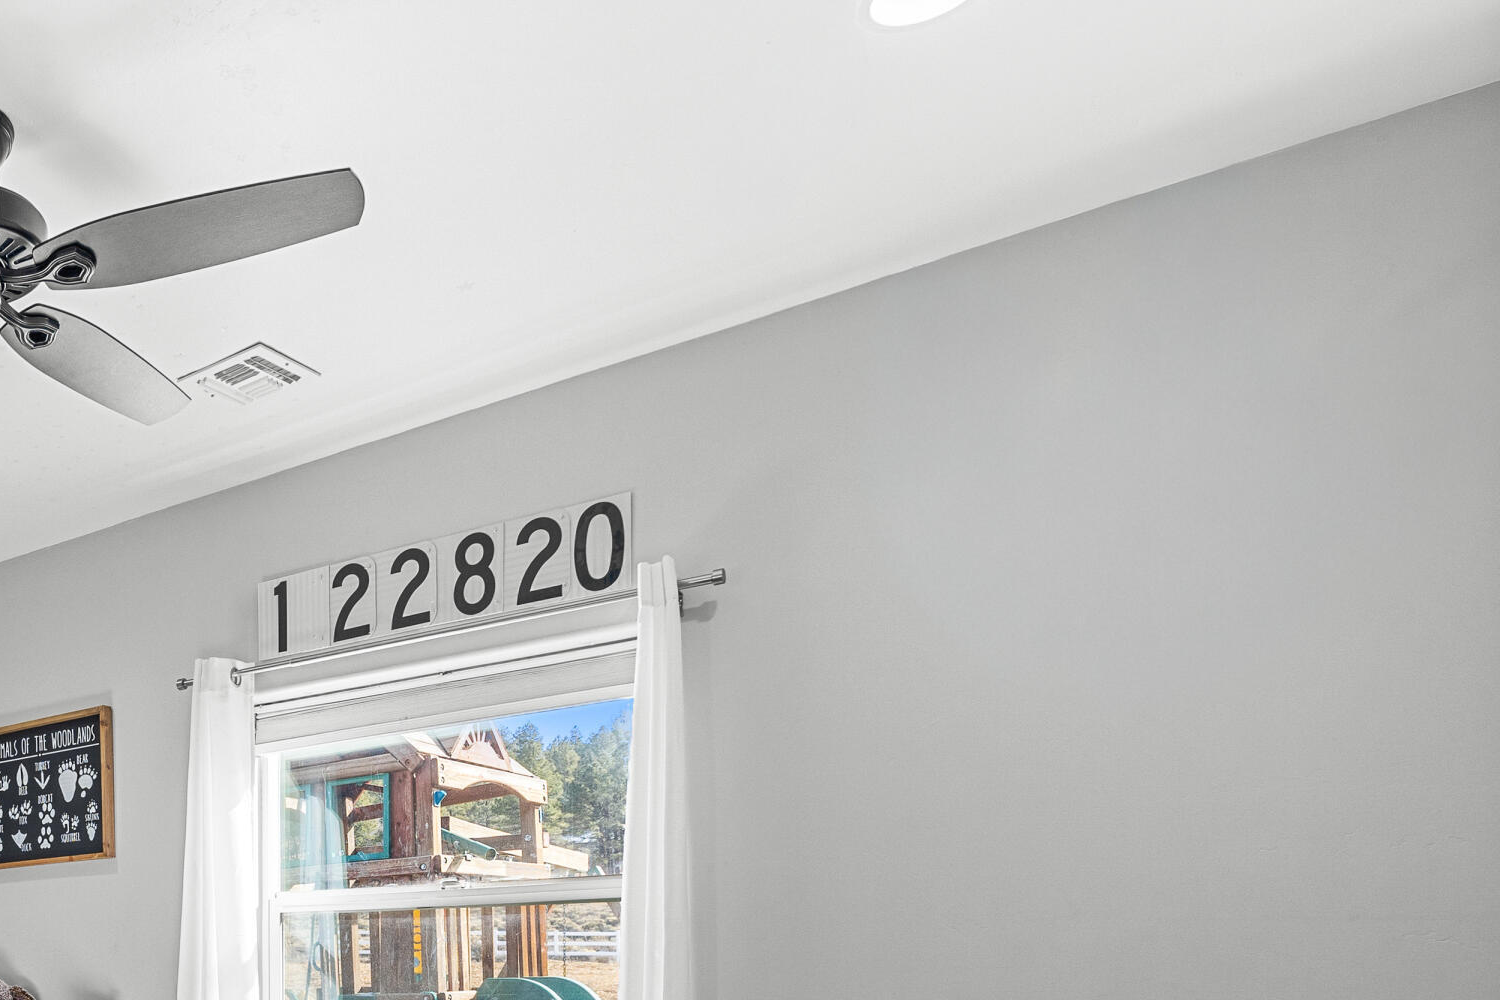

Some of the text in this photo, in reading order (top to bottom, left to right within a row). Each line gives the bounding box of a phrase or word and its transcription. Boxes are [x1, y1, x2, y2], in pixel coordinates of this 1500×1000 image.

[21, 737, 31, 755] OF
[34, 734, 48, 752] THE
[51, 724, 96, 749] WOODLANDS
[76, 753, 89, 765] BEAR
